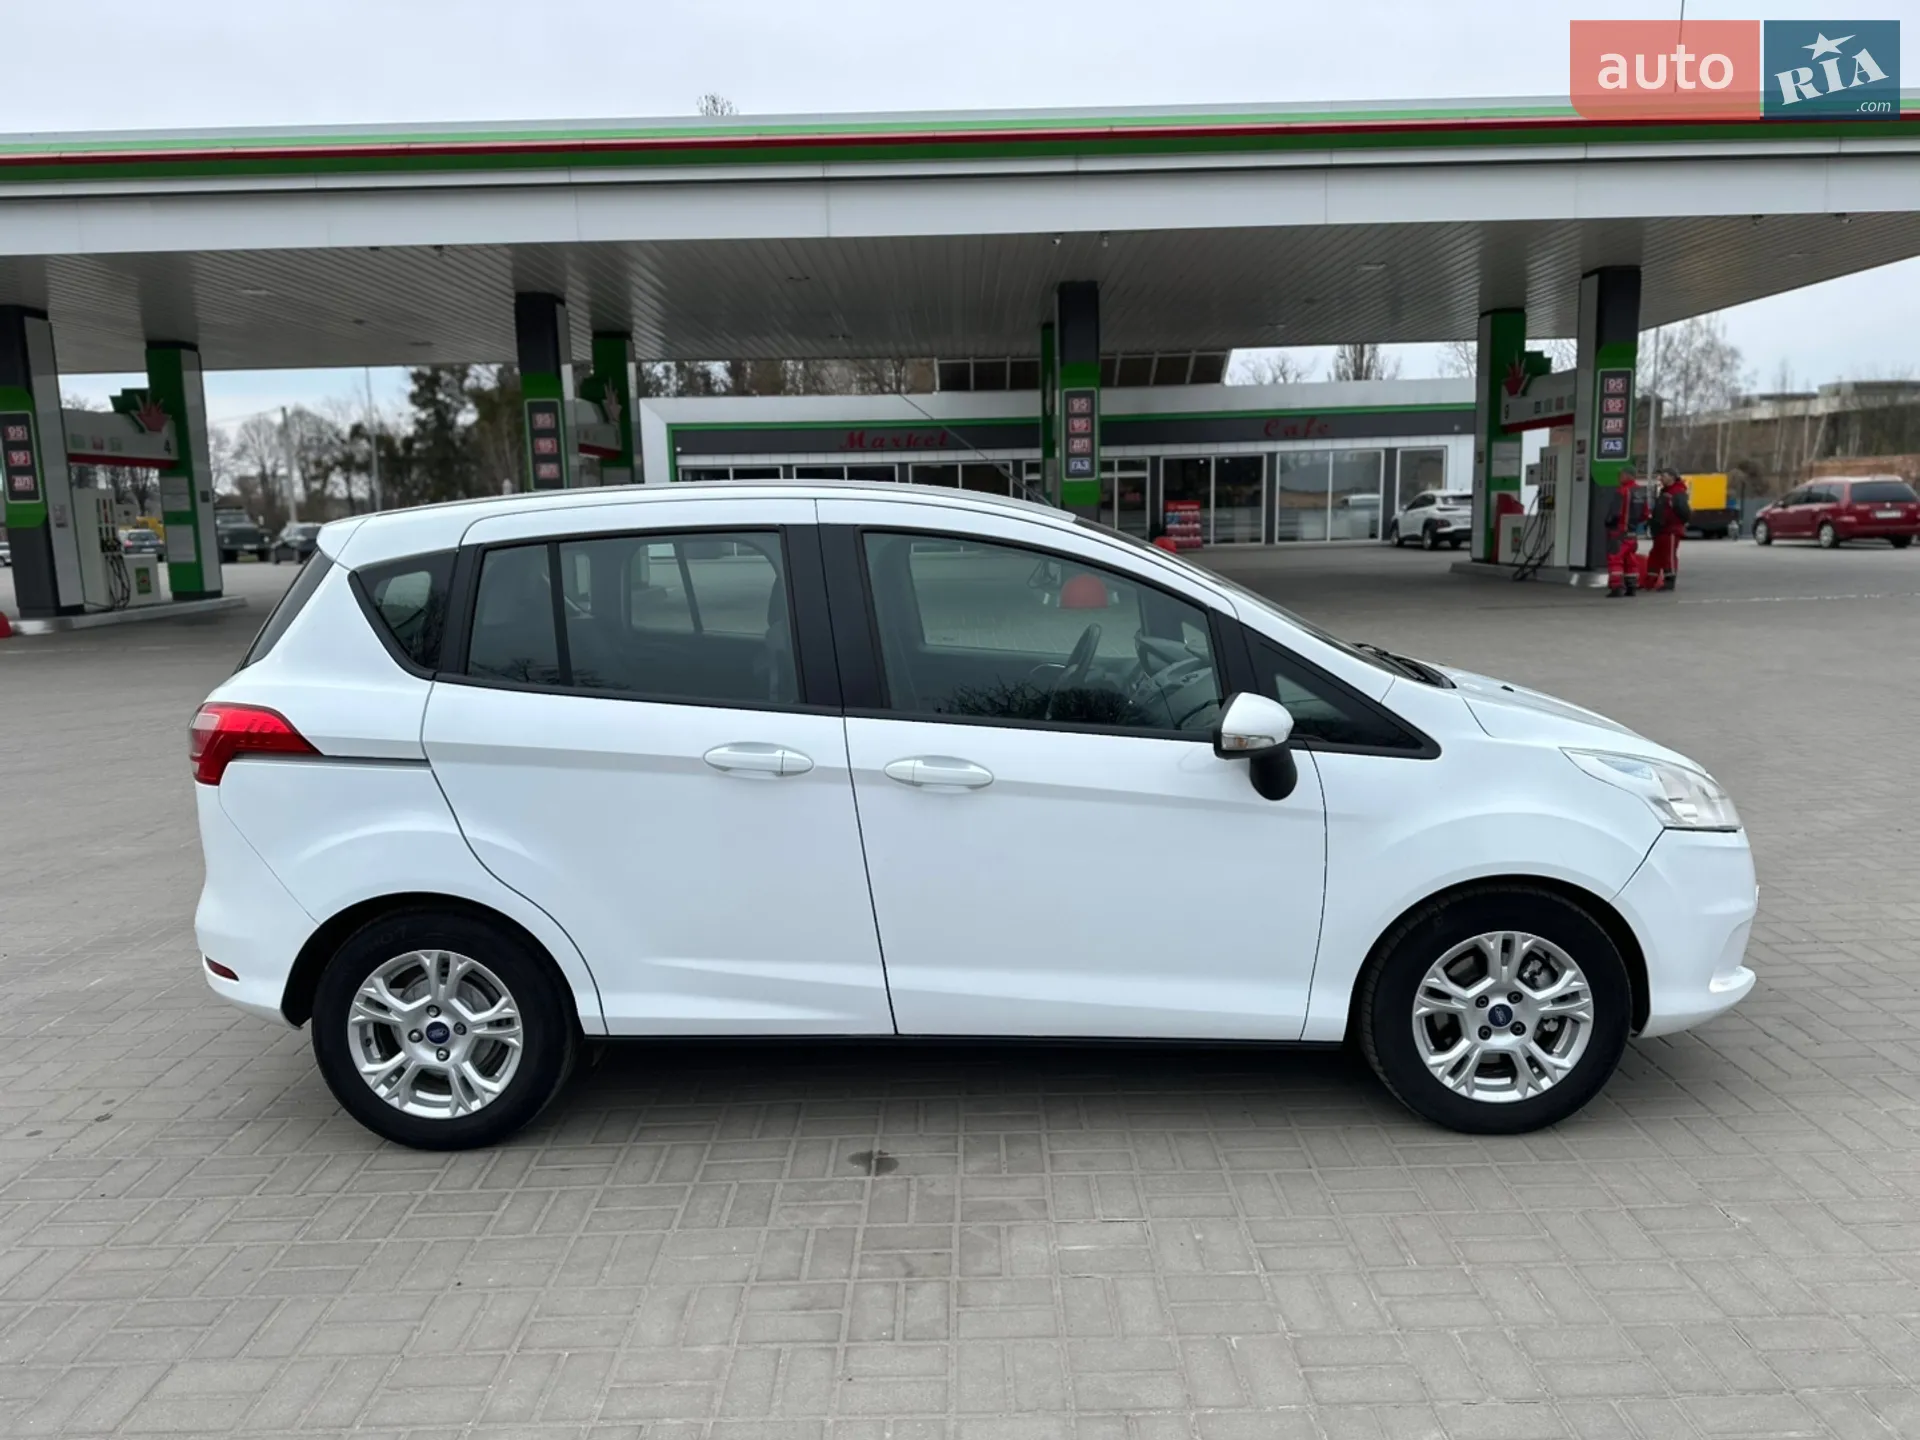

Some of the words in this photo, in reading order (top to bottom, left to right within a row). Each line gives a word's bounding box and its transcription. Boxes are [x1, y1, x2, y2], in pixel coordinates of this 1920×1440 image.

[8, 426, 24, 437] 95
[840, 430, 949, 448] Market
[1604, 441, 1622, 450] ГАЗ
